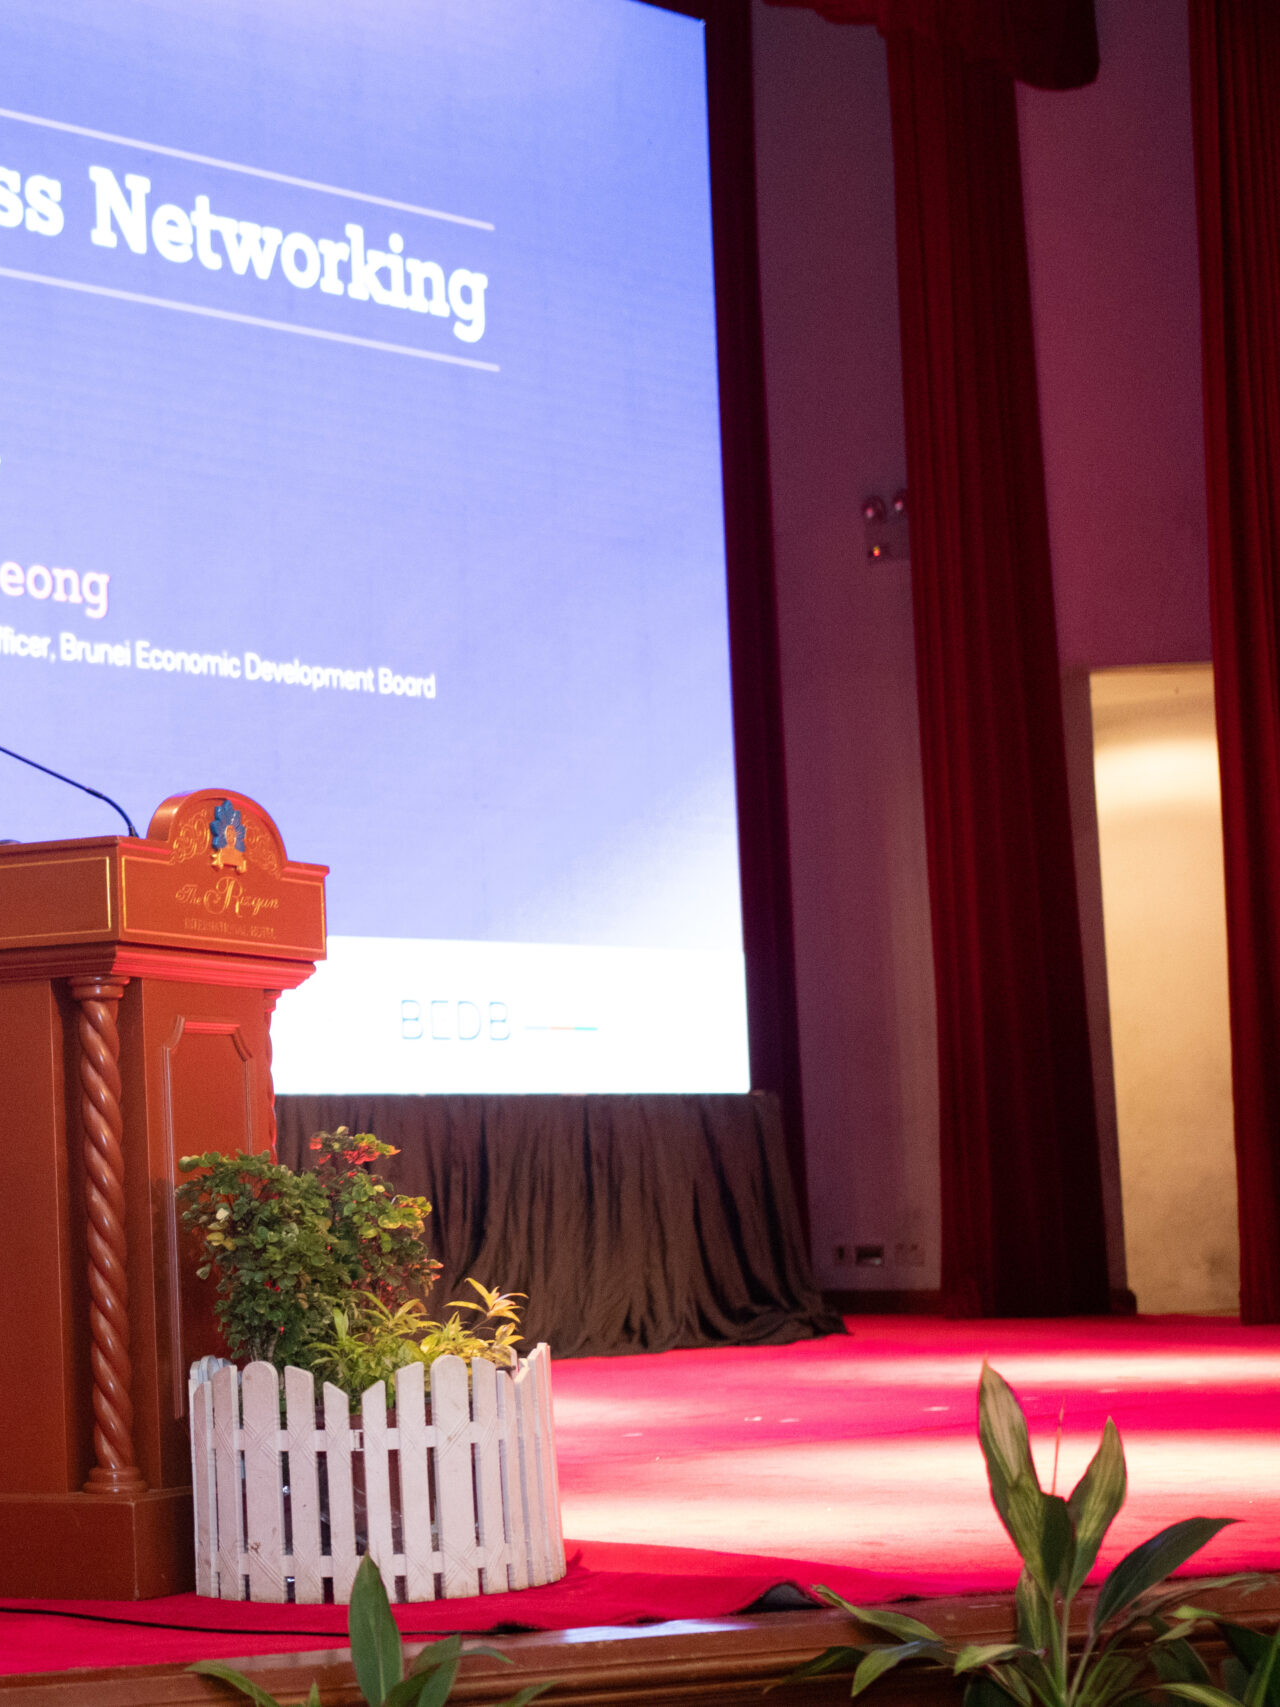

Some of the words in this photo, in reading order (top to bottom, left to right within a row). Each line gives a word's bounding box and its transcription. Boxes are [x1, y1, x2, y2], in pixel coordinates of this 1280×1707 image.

[88, 165, 488, 343] Networking
[59, 631, 132, 667] Brunei
[135, 640, 242, 679] Economic
[244, 652, 376, 693] Development
[377, 666, 436, 699] Board
